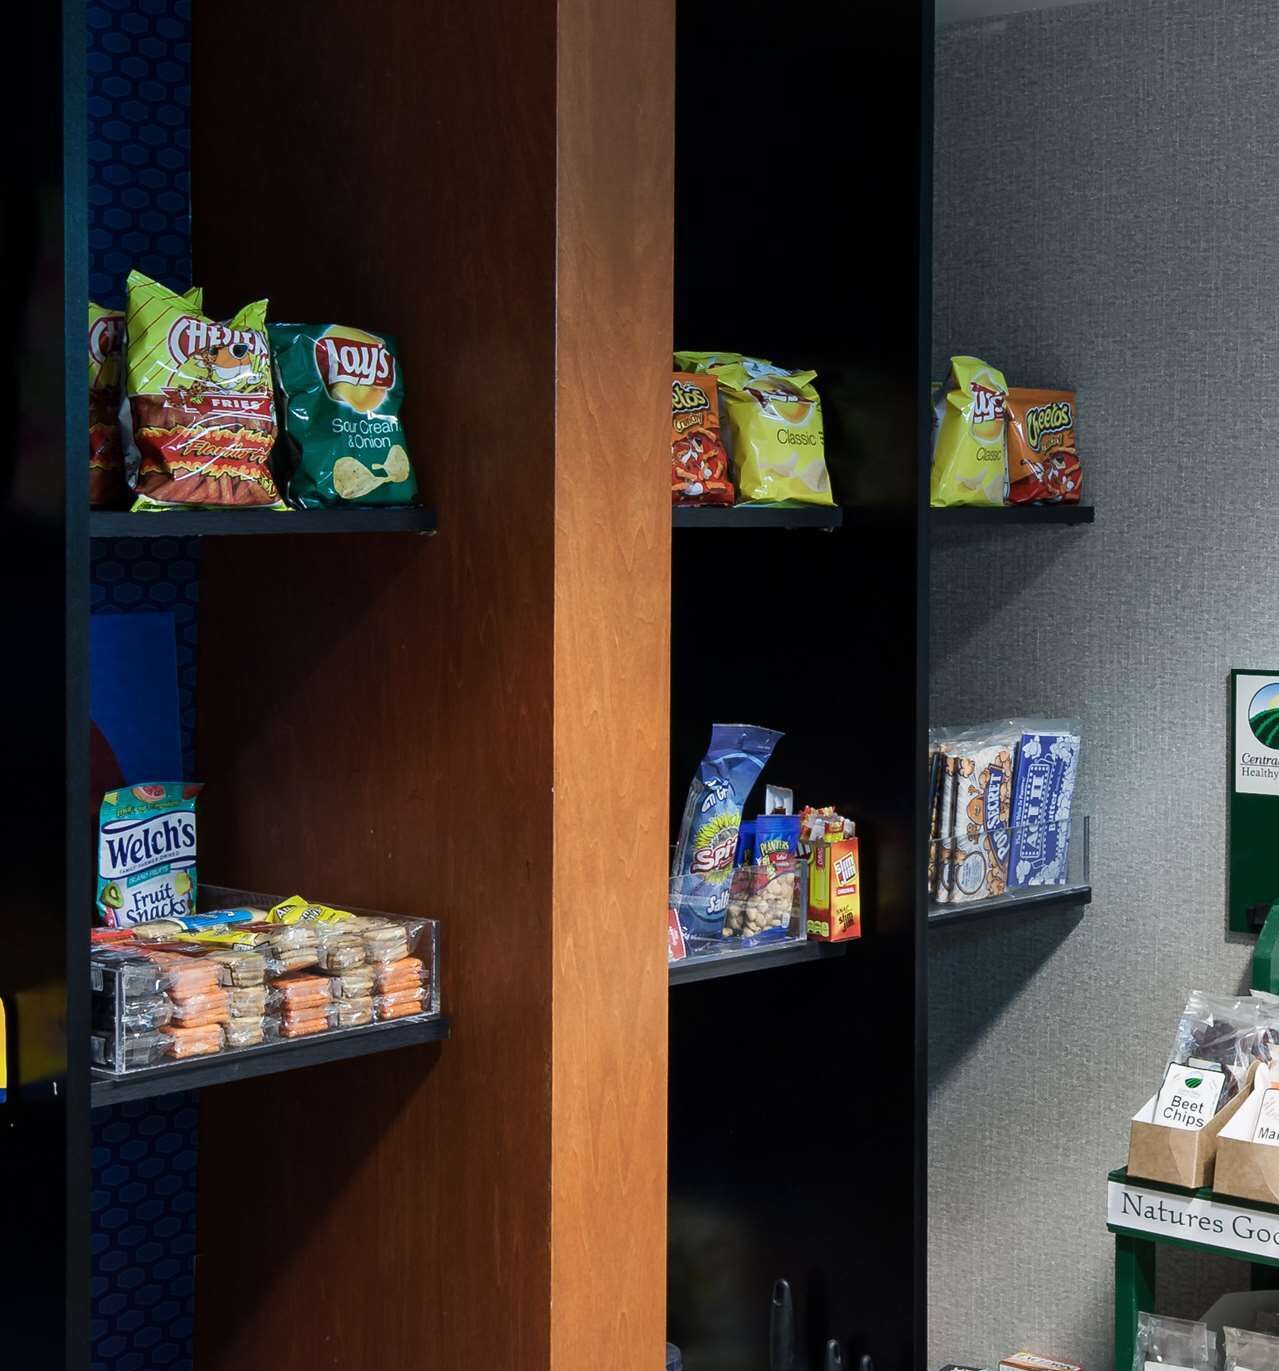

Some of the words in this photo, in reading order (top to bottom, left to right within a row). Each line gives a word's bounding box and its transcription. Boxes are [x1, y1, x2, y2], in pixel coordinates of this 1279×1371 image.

[324, 339, 391, 386] Lay's
[212, 399, 260, 410] FRIES
[332, 418, 357, 433] Sour
[777, 429, 817, 445] Classic
[1026, 402, 1071, 450] Cheetos
[355, 434, 391, 449] Onion
[1241, 767, 1278, 781] Healthy
[987, 772, 1002, 829] SECRET
[1031, 776, 1045, 800] II
[1048, 793, 1058, 831] Butter
[1026, 805, 1040, 848] ACT
[106, 818, 195, 869] Welch's
[992, 828, 1010, 860] POP
[126, 897, 186, 923] Snacks
[133, 882, 174, 911] Fruit
[1171, 1095, 1204, 1113] Beet
[1162, 1107, 1204, 1129] Chips
[1122, 1191, 1223, 1233] Natures
